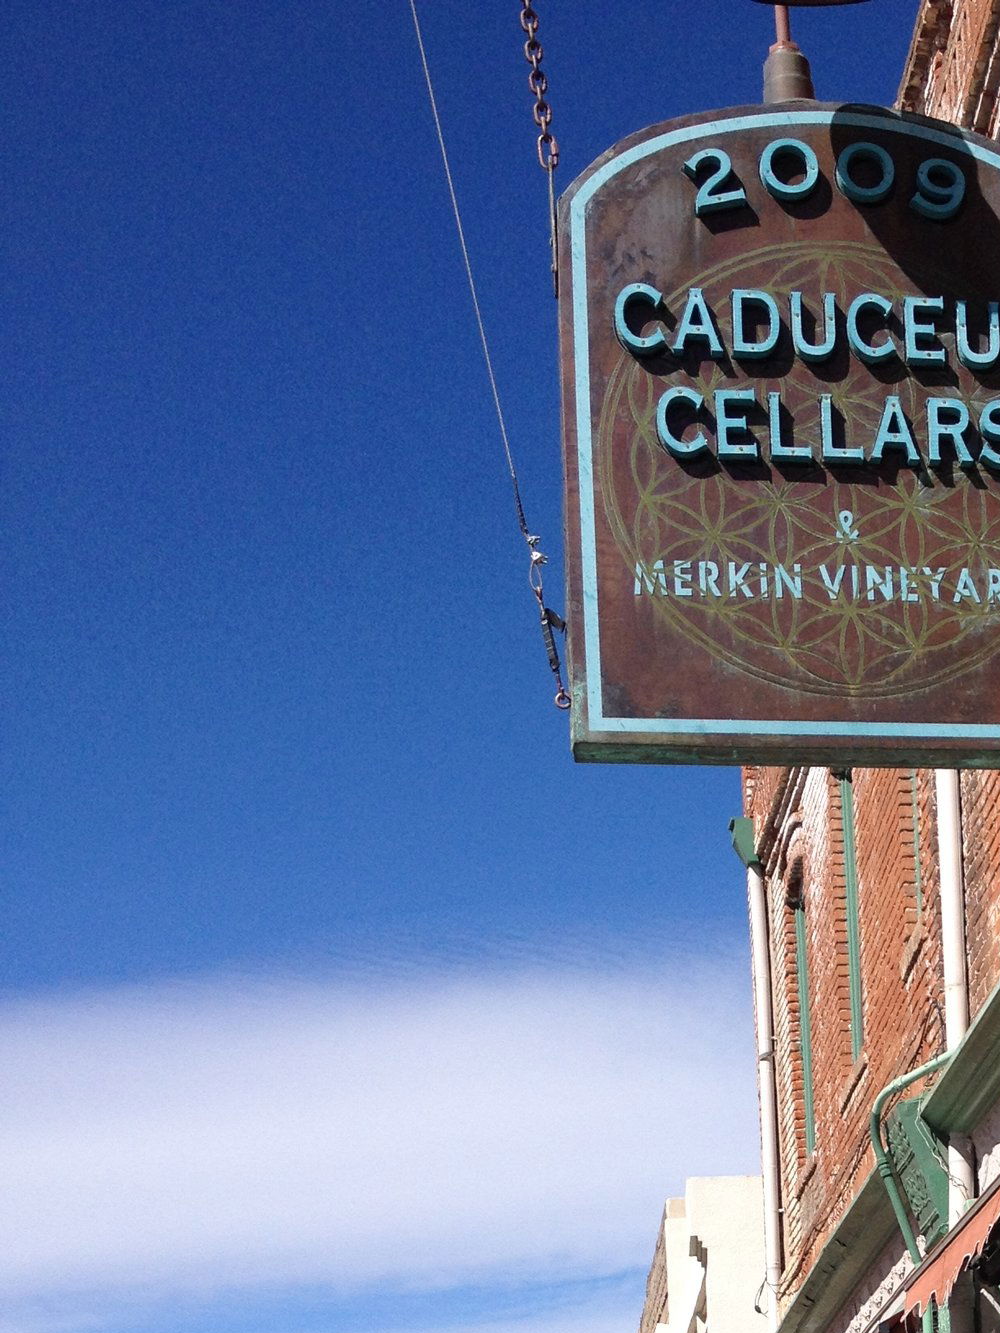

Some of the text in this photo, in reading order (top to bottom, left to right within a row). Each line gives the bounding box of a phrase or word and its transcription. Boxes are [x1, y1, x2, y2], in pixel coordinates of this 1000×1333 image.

[683, 138, 967, 220] 2009
[835, 510, 860, 544] &
[633, 560, 802, 600] MERKIN
